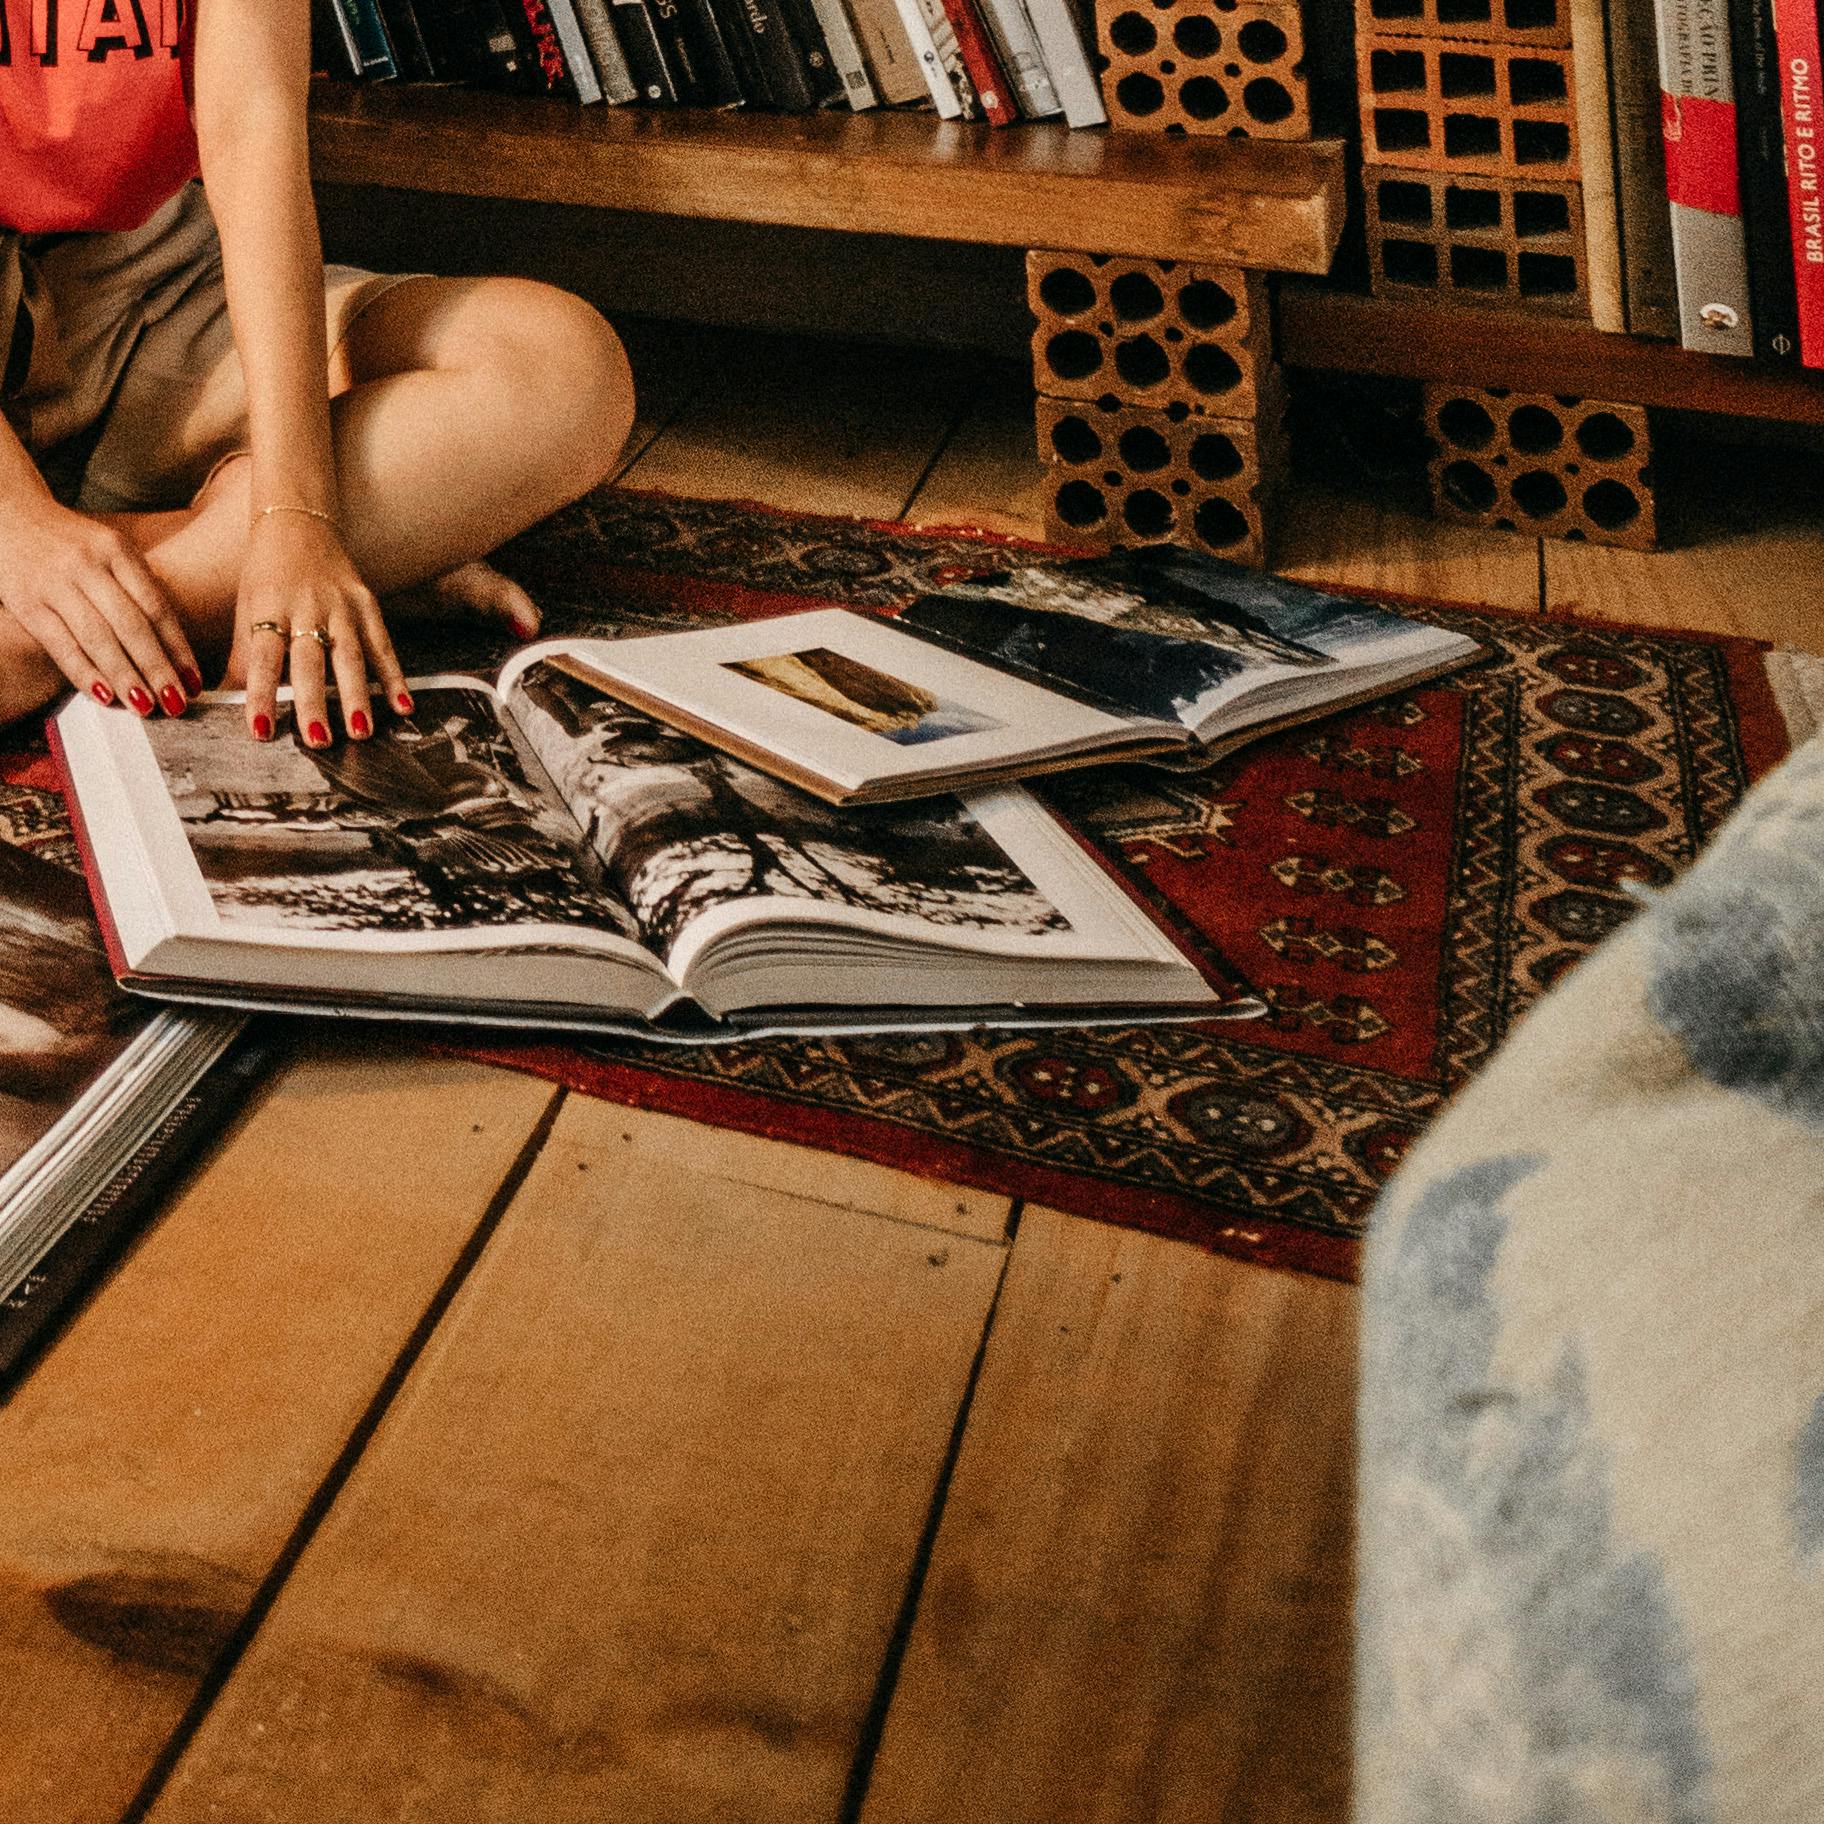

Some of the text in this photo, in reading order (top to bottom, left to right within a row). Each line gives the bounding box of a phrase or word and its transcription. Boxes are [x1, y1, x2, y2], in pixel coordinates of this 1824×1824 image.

[1790, 56, 1823, 262] BRASIL RITO E RITMO
